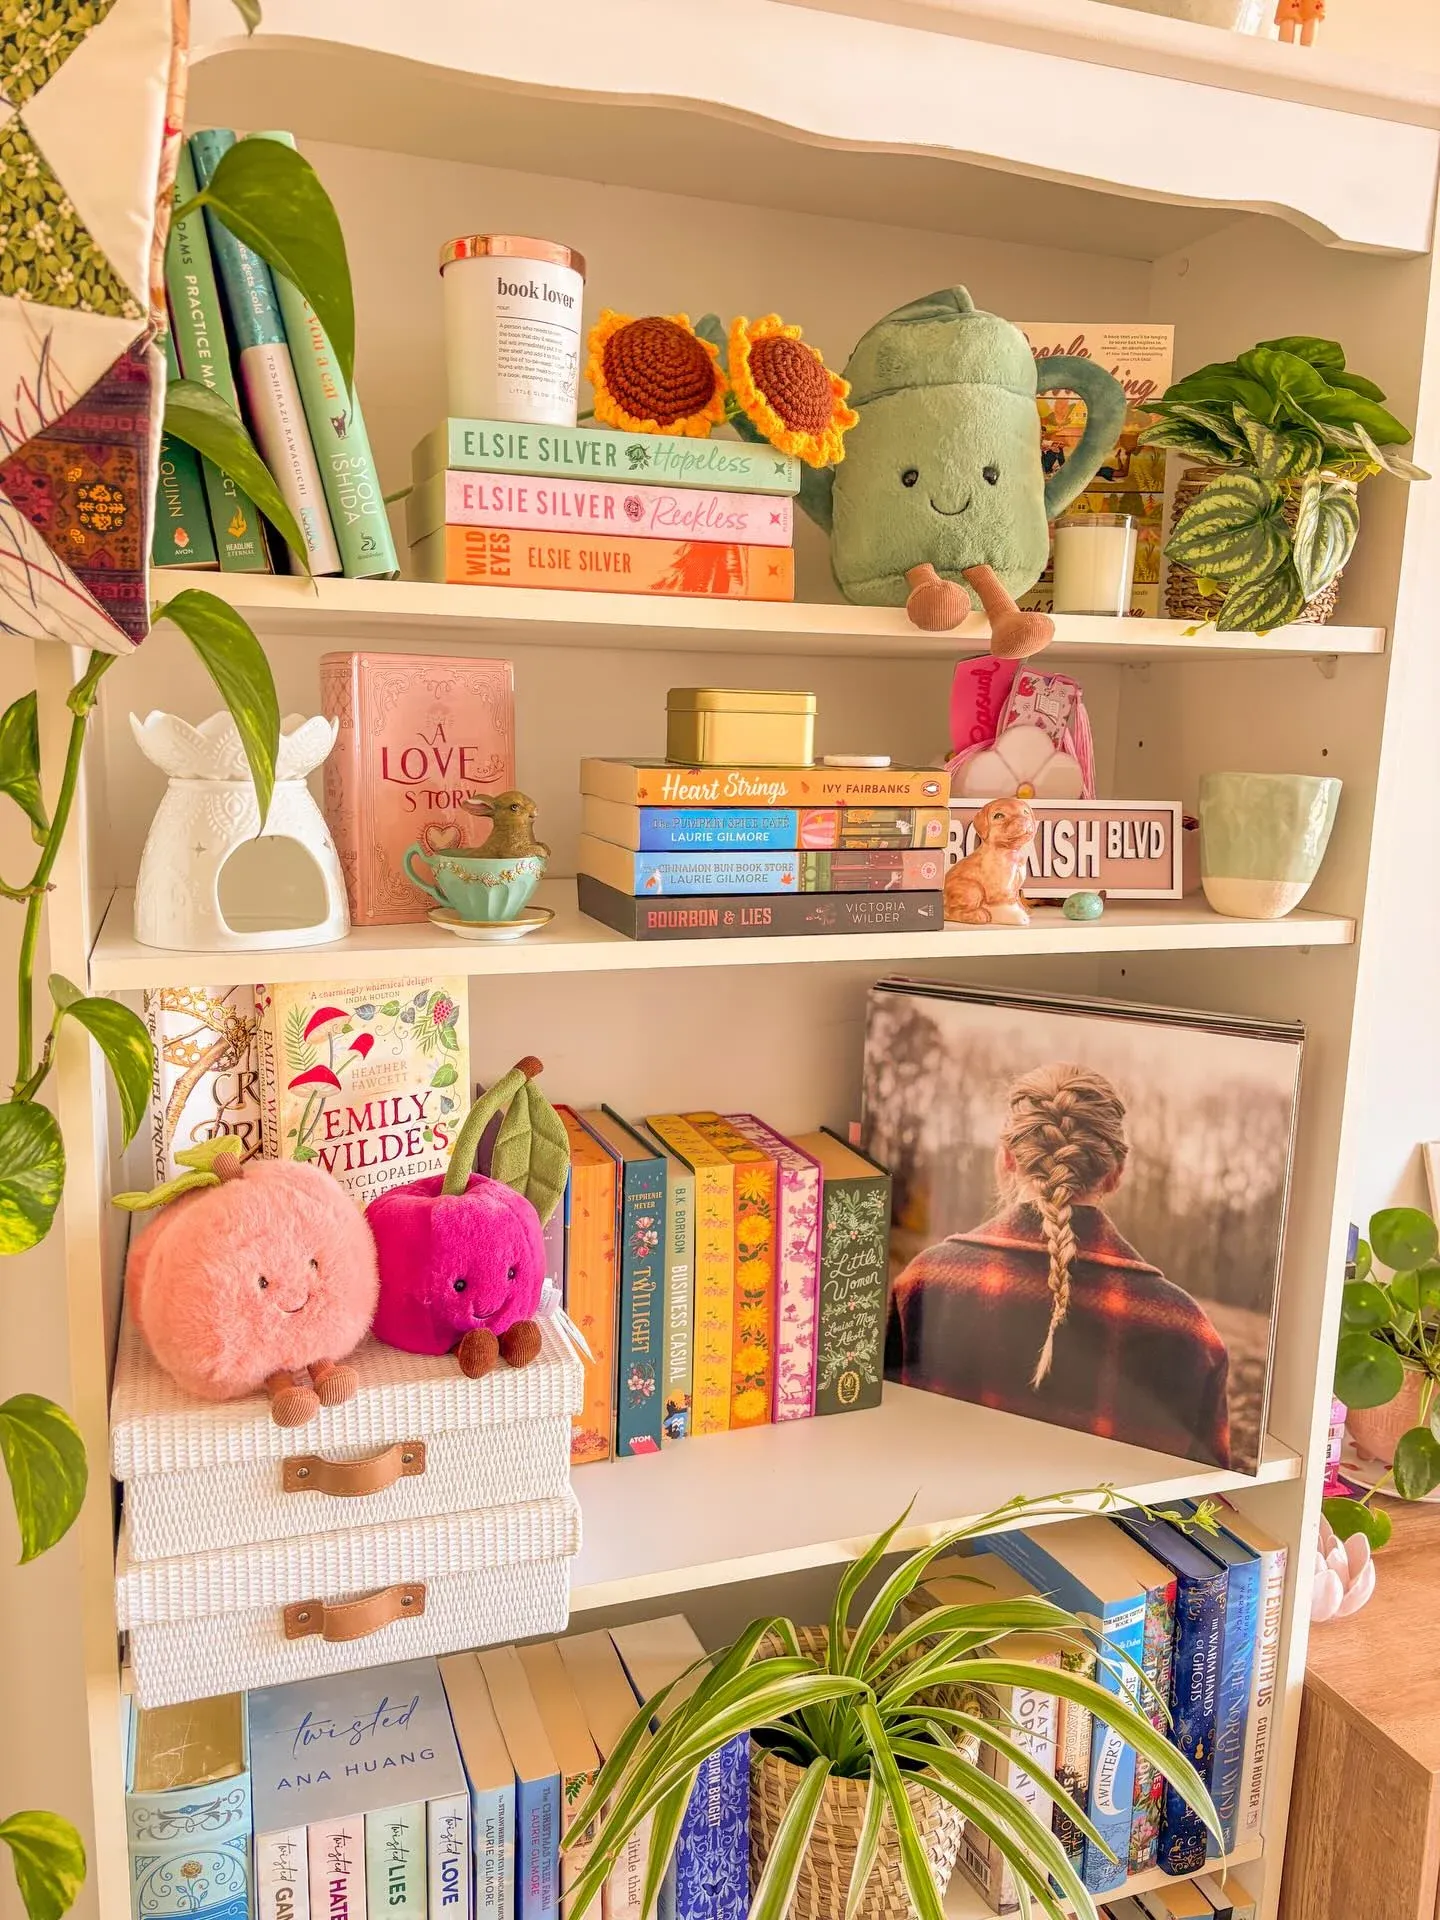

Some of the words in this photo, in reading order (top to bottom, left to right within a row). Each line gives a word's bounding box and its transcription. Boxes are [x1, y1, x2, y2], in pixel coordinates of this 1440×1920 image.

[176, 221, 192, 266] DAMS
[241, 264, 255, 288] gets
[251, 290, 264, 315] cold
[497, 277, 539, 300] book
[543, 283, 575, 310] lover
[184, 275, 212, 359] PRACTICE
[306, 315, 325, 351] you
[316, 357, 329, 367] a
[1023, 333, 1092, 359] eople
[321, 373, 339, 400] cat
[266, 356, 291, 425] TOSHIKAZU
[285, 428, 308, 497] KAWAGUCHI
[463, 430, 529, 463] ELSIE
[538, 436, 617, 468] SILVER
[652, 441, 753, 480] Hopeless
[160, 461, 184, 518] QUINN
[330, 452, 361, 526] ISHIDA
[350, 456, 378, 515] SYOU
[463, 483, 528, 514] ELSIE
[536, 490, 615, 520] SILVER
[649, 497, 750, 530] Reckless
[226, 542, 254, 551] HEADLINE
[465, 530, 488, 577] WILD
[489, 530, 512, 578] EYES
[528, 546, 572, 569] ELSIE
[579, 549, 632, 574] SILVER
[416, 723, 446, 746] A
[381, 746, 504, 785] LOVE
[404, 789, 477, 812] STORY
[661, 773, 720, 801] Heart
[724, 772, 788, 805] Strings
[822, 784, 842, 794] IVY
[846, 784, 911, 795] FAIRBANKS
[671, 832, 713, 842] LAURIE
[717, 832, 770, 842] GILMORE
[672, 817, 725, 829] PUMPKIN
[727, 817, 759, 829] SPICE
[658, 863, 712, 874] CINNAMON
[714, 863, 734, 873] BUN
[736, 863, 763, 872] BOOK
[764, 862, 794, 873] STORE
[946, 819, 1100, 878] BISH
[1106, 821, 1165, 859] BLVD
[670, 874, 712, 884] LAURIE
[716, 873, 769, 883] GILMORE
[647, 909, 719, 929] BOURBON
[723, 911, 735, 925] &
[741, 908, 772, 925] LIES
[845, 901, 906, 913] VICTORIA
[851, 913, 901, 923] WILDER
[318, 986, 364, 999] charmingly
[365, 981, 405, 992] whimsical
[345, 996, 368, 1004] INDIA
[369, 990, 400, 1001] HOLTON
[263, 1030, 276, 1092] EMILY
[351, 1061, 408, 1079] HEATHER
[148, 1011, 156, 1037] THE
[152, 1110, 166, 1184] PRINCE
[352, 1074, 409, 1091] FAWCETT
[267, 1098, 279, 1160] WILDE
[323, 1091, 432, 1141] EMILY
[316, 1122, 449, 1174] WILDE'S
[337, 1158, 443, 1190] YCLOPAEDIA
[627, 1191, 663, 1202] STEPHENIE
[633, 1201, 656, 1210] MEYER
[675, 1187, 686, 1205] B.K.
[675, 1210, 686, 1254] BORISON
[829, 1248, 877, 1279] Little
[670, 1264, 688, 1328] BUSINESS
[823, 1271, 881, 1302] Women
[631, 1266, 657, 1354] TWILIGHT
[825, 1319, 854, 1338] Louisa
[853, 1311, 878, 1328] May
[836, 1327, 866, 1347] Alcott
[670, 1333, 687, 1384] CASUAL
[629, 1435, 651, 1445] ATOM
[1268, 1576, 1283, 1590] IT
[1112, 1613, 1129, 1623] MIRROR
[1129, 1608, 1144, 1617] VISITOR
[1115, 1620, 1128, 1628] BOOK
[1235, 1585, 1245, 1632] WARWICK
[1243, 1577, 1253, 1638] ALEXANDRIA
[1263, 1600, 1281, 1638] ENDS
[1163, 1633, 1173, 1654] ALL
[1206, 1632, 1219, 1673] WARM
[1260, 1640, 1278, 1682] WITH
[1144, 1657, 1158, 1712] TRNT
[1159, 1658, 1170, 1681] OUR
[1190, 1652, 1205, 1702] GHOSTS
[1231, 1660, 1245, 1690] THE
[1156, 1686, 1170, 1734] SHMER
[1203, 1675, 1216, 1717] HANDS
[1257, 1686, 1274, 1707] US
[275, 1695, 420, 1760] twisted
[1016, 1688, 1035, 1790] ORTN
[1035, 1700, 1049, 1753] KATE
[1079, 1706, 1091, 1757] WHERE
[1217, 1694, 1245, 1764] NORTH
[1253, 1717, 1268, 1765] COLLEEN
[277, 1770, 331, 1791] ANA
[345, 1748, 435, 1776] HUANG
[708, 1751, 721, 1785] BURN
[1077, 1762, 1088, 1791] THE
[1099, 1740, 1122, 1799] WINTER'S
[1249, 1766, 1264, 1808] HOOVER
[708, 1786, 721, 1828] BRIGHT
[1219, 1771, 1240, 1820] WIND
[384, 1817, 409, 1863] twisted
[438, 1809, 464, 1855] twisted
[485, 1818, 495, 1856] LAURIE
[531, 1807, 541, 1845] LAURIE
[541, 1803, 552, 1857] CHRISTMAS
[271, 1836, 298, 1883] twisted
[325, 1828, 352, 1875] twisted
[531, 1848, 541, 1896] GILMORE
[541, 1859, 551, 1885] TREE
[628, 1840, 641, 1872] little
[329, 1878, 349, 1920] HATE
[388, 1865, 406, 1906] LIES
[441, 1858, 459, 1906] LOVE
[485, 1859, 495, 1907] GILMORE
[541, 1885, 550, 1911] FARM
[628, 1876, 641, 1906] thief
